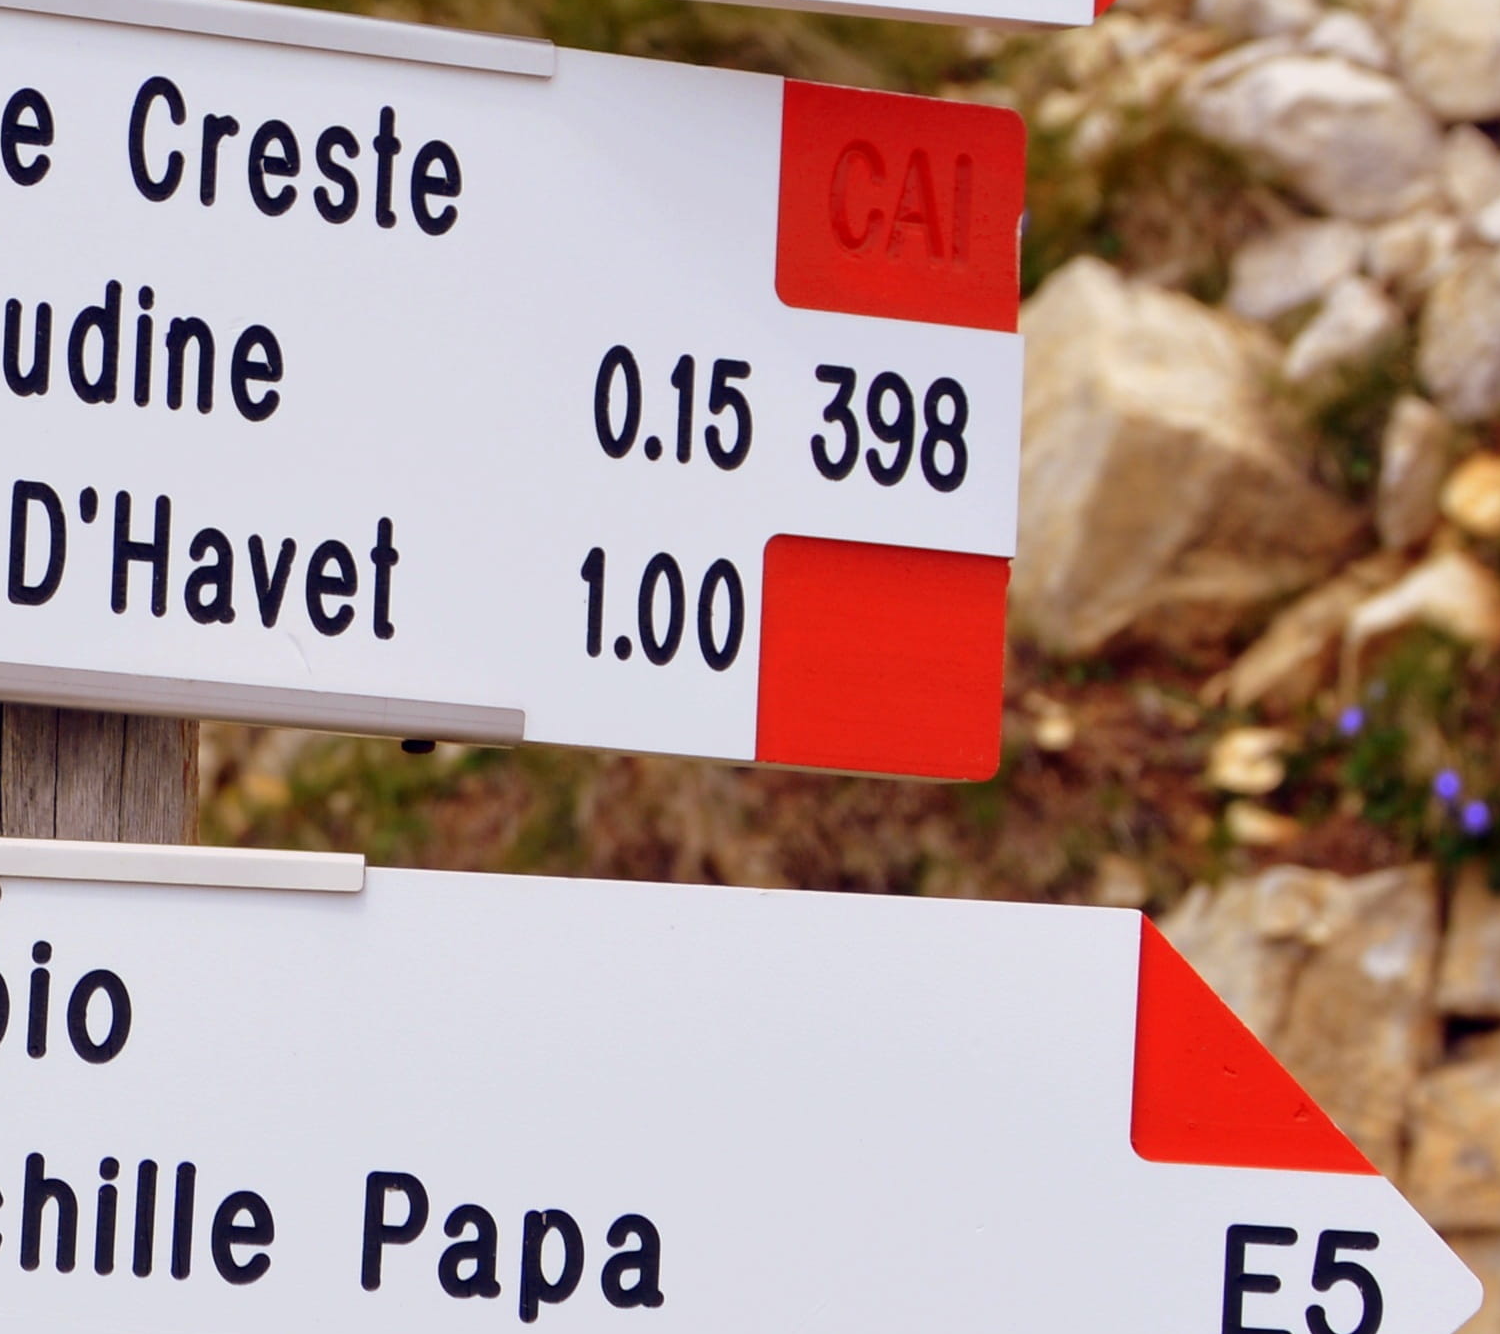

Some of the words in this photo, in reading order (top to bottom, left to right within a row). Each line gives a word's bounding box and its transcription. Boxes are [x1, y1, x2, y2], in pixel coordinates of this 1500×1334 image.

[127, 75, 463, 237] Creste
[828, 138, 974, 265] CAI
[593, 344, 754, 472] 0.15
[809, 363, 970, 494] 398
[6, 478, 400, 641] D'Havet
[579, 546, 746, 673] 1.00
[360, 1170, 666, 1325] Papa
